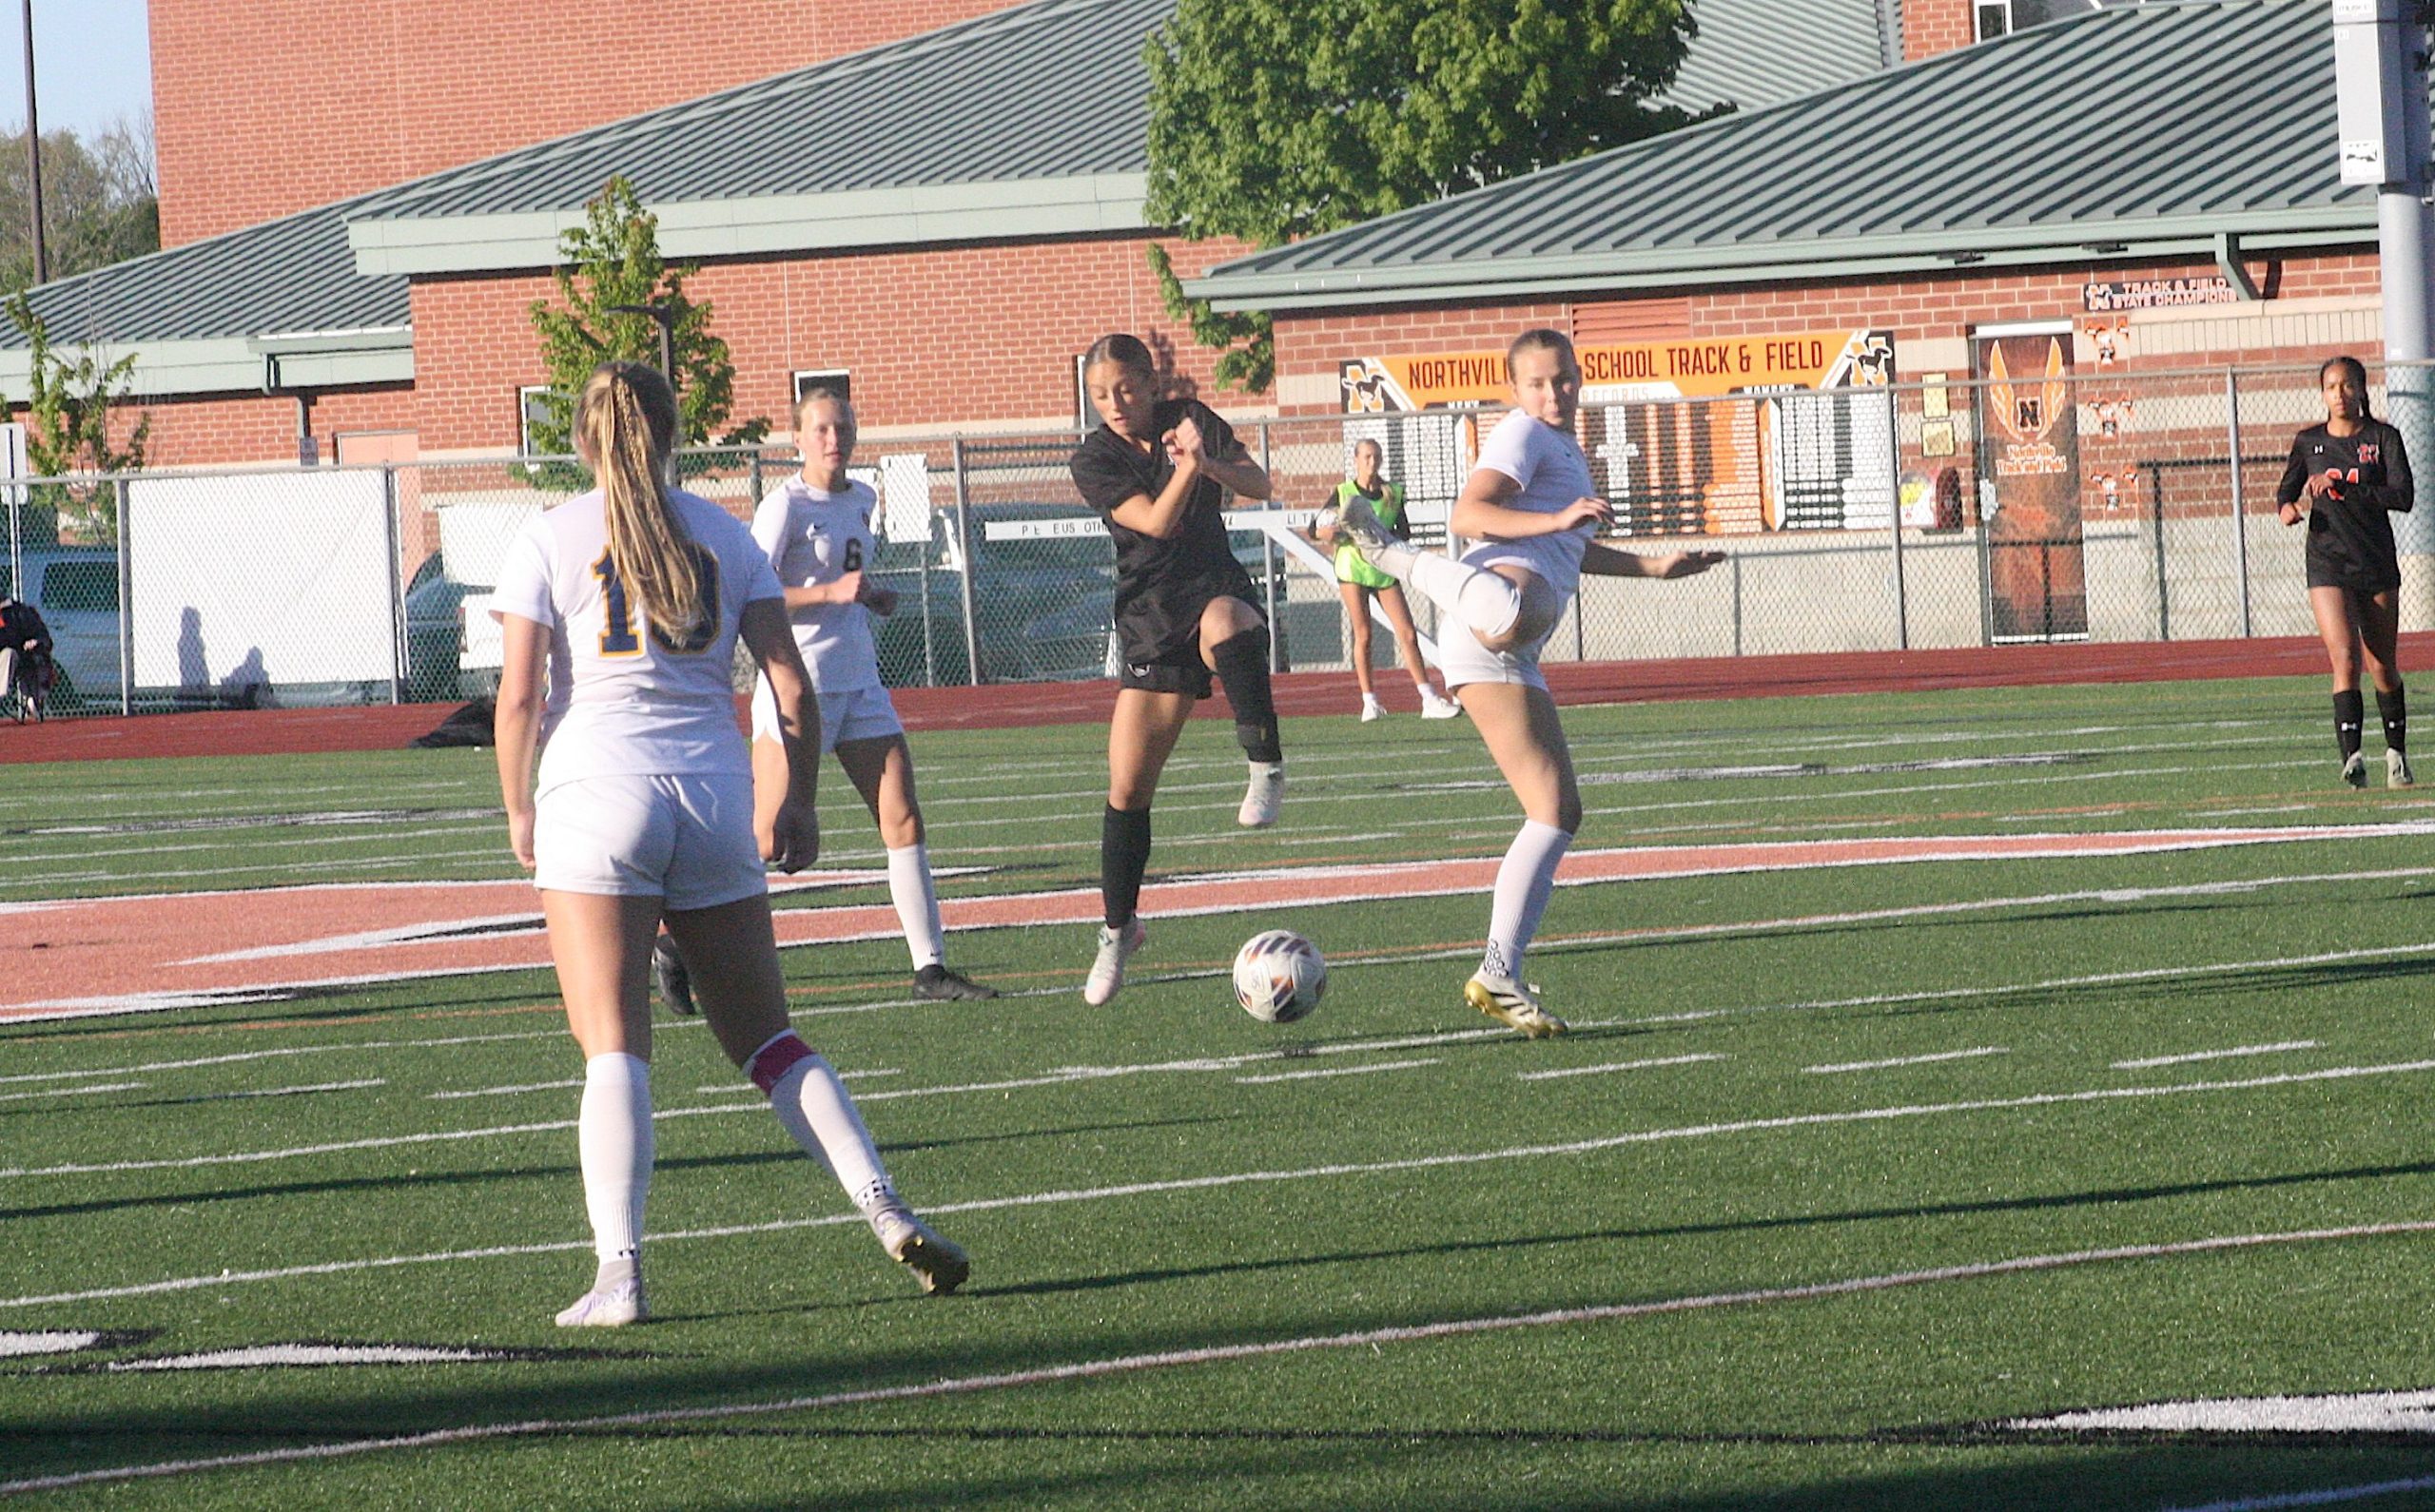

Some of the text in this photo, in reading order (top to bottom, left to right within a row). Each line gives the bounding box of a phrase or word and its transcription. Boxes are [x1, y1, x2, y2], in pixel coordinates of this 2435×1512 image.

[2112, 287, 2237, 309] STATE CHAMPIONS
[2122, 278, 2228, 295] TRACK & FIELD
[1408, 340, 1823, 389] NORTHVILL SCHOOL TRACK & FIELD
[2016, 397, 2042, 432] N
[590, 540, 722, 658] 10
